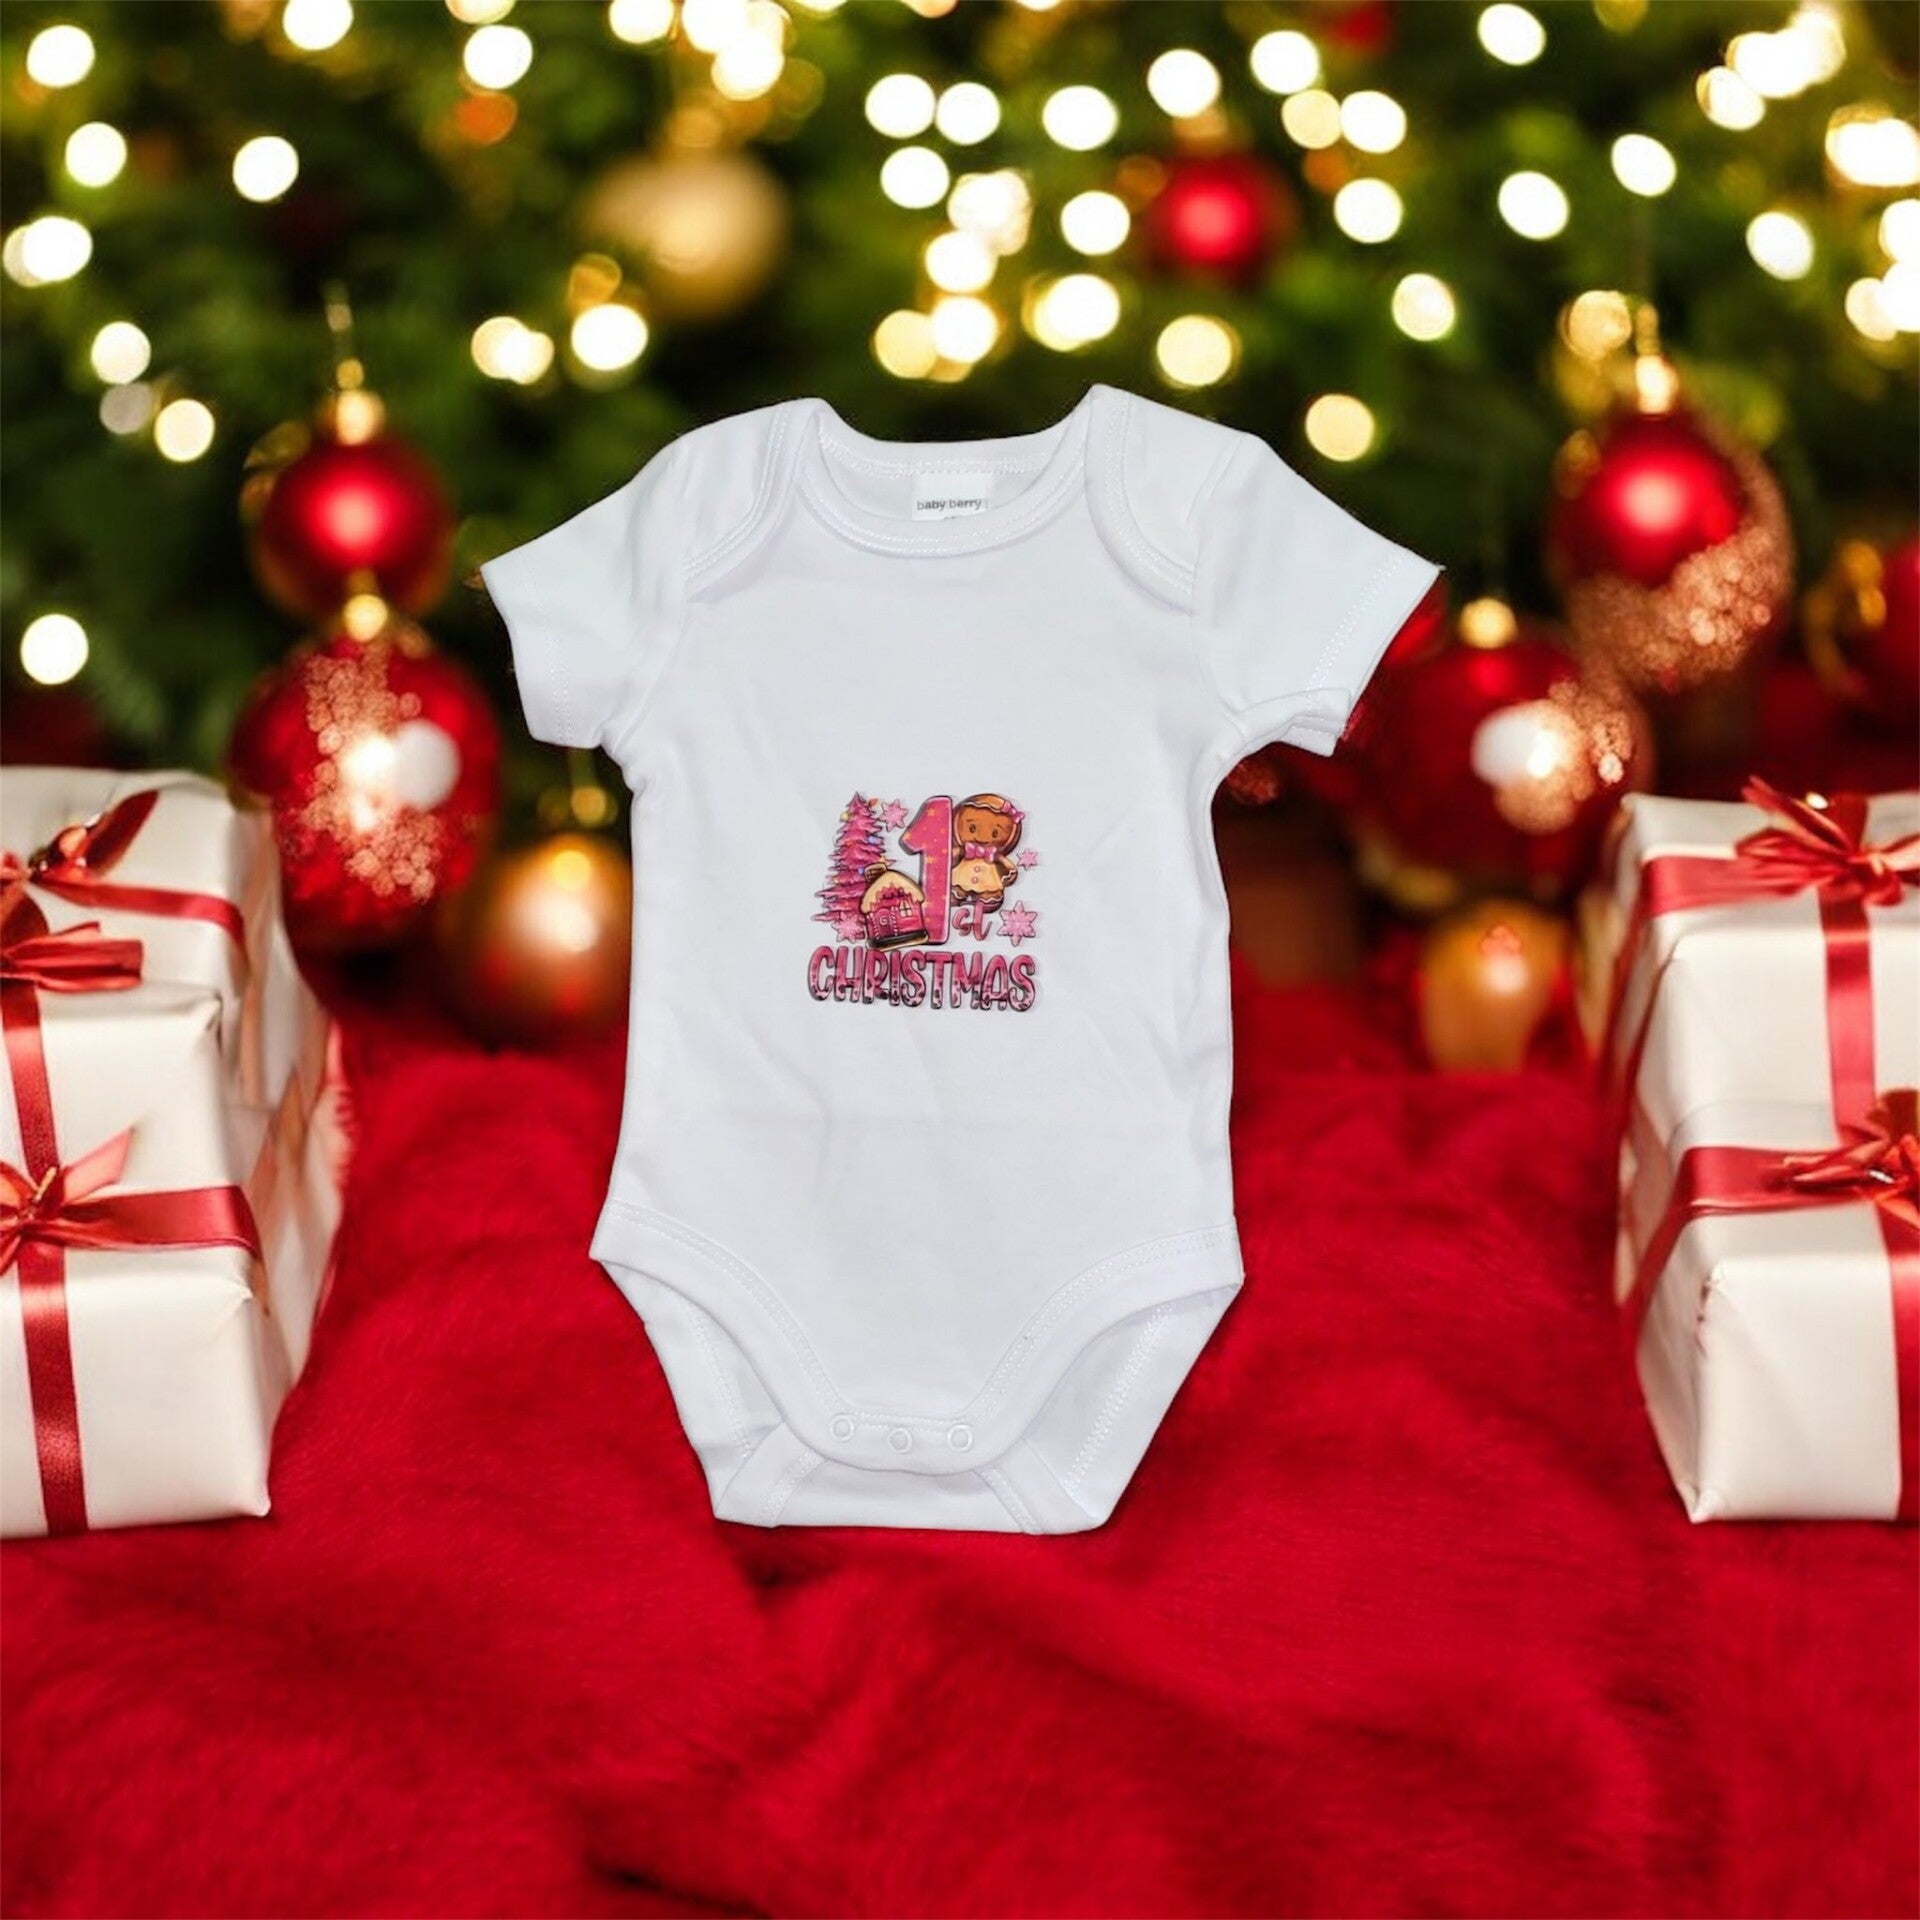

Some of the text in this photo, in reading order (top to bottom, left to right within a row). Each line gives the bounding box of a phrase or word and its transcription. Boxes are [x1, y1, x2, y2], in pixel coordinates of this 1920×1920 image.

[917, 498, 982, 512] baby berry
[807, 946, 1036, 1012] CHRISTMAS
